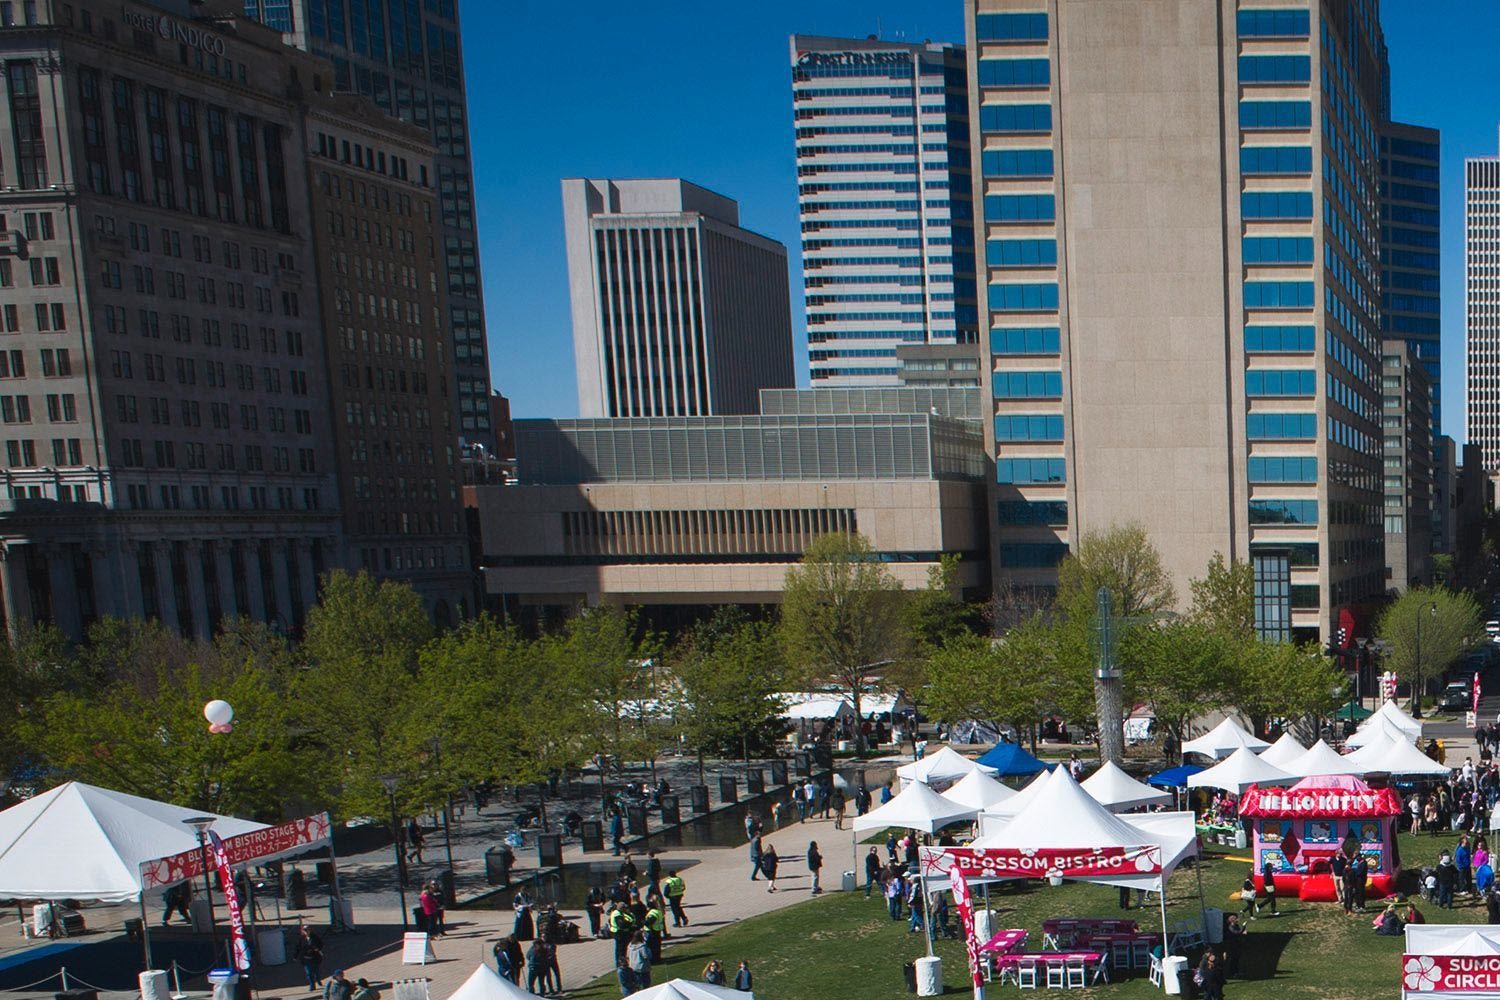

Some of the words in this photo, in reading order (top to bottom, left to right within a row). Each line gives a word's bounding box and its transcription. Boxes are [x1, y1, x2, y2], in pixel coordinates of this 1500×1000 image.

[172, 22, 226, 56] INDIGO
[1259, 796, 1314, 811] HELLO
[1318, 794, 1376, 810] KITTY
[234, 830, 267, 849] BISTRO
[269, 823, 296, 841] STAGE
[960, 856, 1048, 870] BLOSSOM
[1054, 855, 1122, 868] BISTRO
